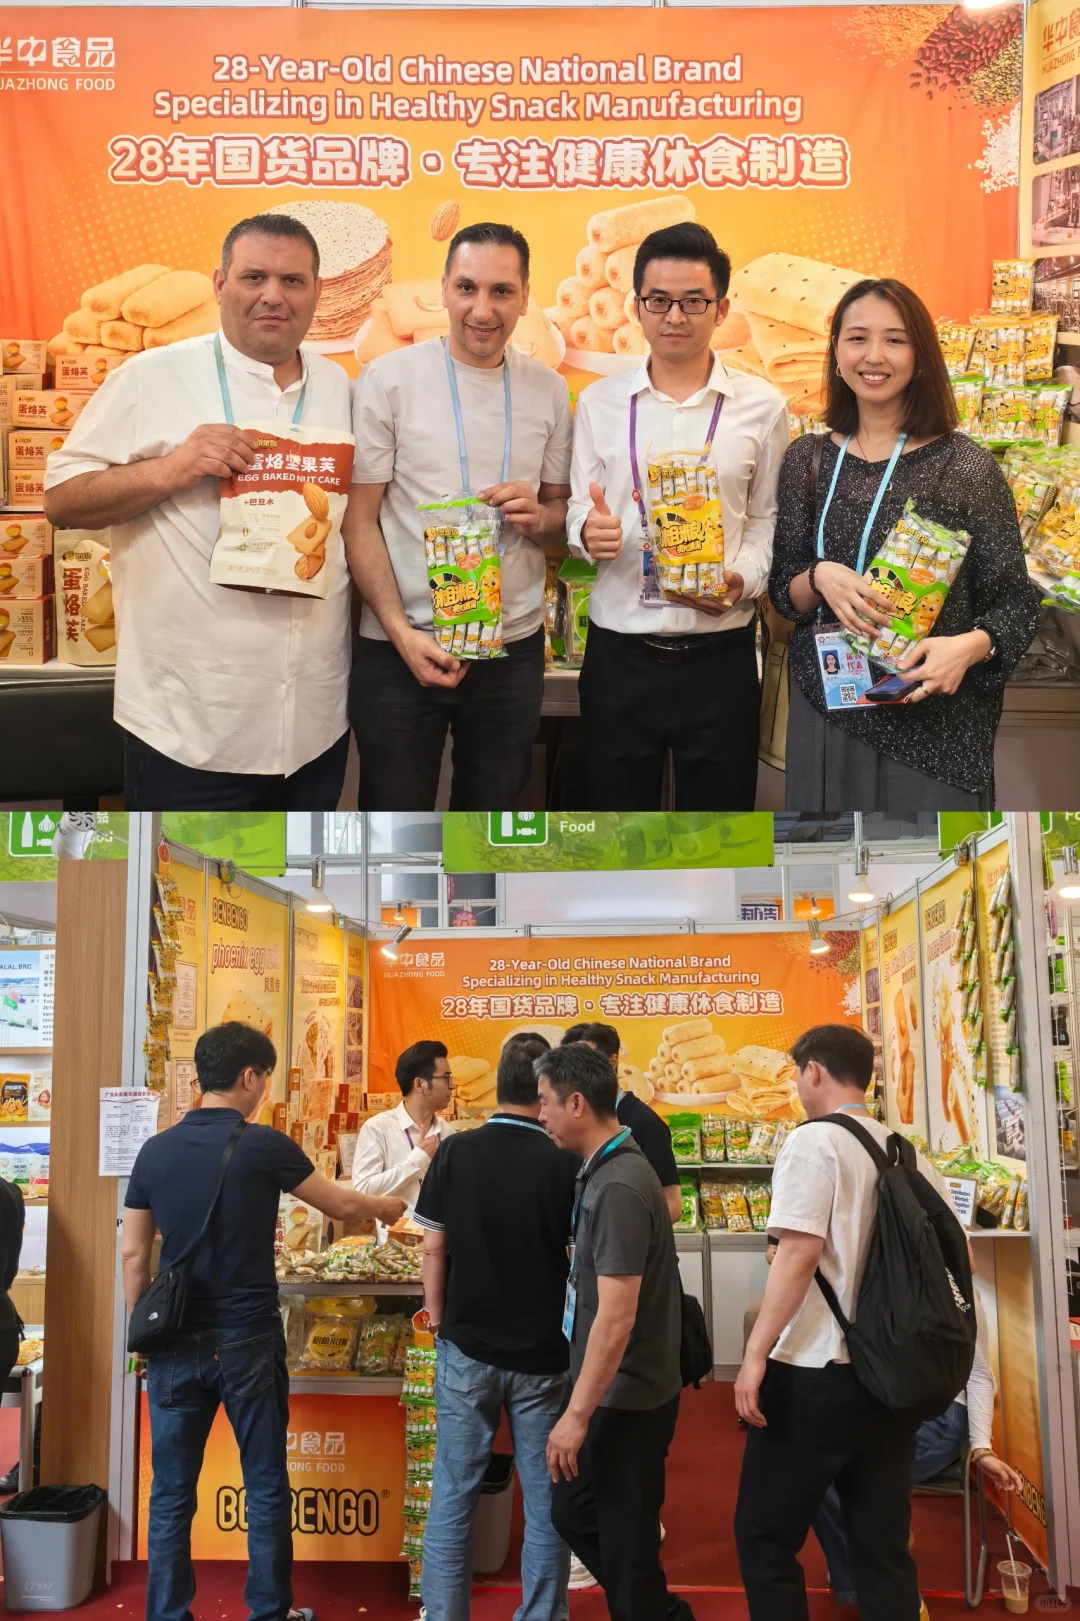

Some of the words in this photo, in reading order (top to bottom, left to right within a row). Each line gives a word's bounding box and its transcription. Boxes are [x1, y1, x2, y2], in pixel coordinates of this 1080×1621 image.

[213, 54, 393, 83] 28-Year-Old
[400, 55, 513, 84] Chinese
[520, 54, 646, 83] National
[653, 53, 743, 83] Brand
[75, 78, 115, 90] FOOD
[154, 89, 327, 123] Specializing
[336, 90, 363, 117] in
[371, 91, 485, 125] Healthy
[490, 91, 578, 119] Snack
[585, 89, 803, 123] Manufacturing
[237, 474, 259, 482] EGG
[262, 472, 296, 482] BAKED
[296, 475, 317, 484] NUT
[318, 475, 341, 486] CAKE
[560, 820, 595, 832] Food
[249, 946, 265, 976] egg
[489, 957, 571, 971] 28-Year-Old
[573, 956, 626, 970] Chinese
[629, 955, 688, 969] National
[690, 954, 731, 968] Brand
[461, 974, 542, 990] Specializing
[544, 973, 558, 986] in
[561, 972, 613, 988] Healthy
[615, 972, 657, 985] Snack
[659, 970, 760, 986] Manufacturing
[316, 1463, 345, 1473] FOOD
